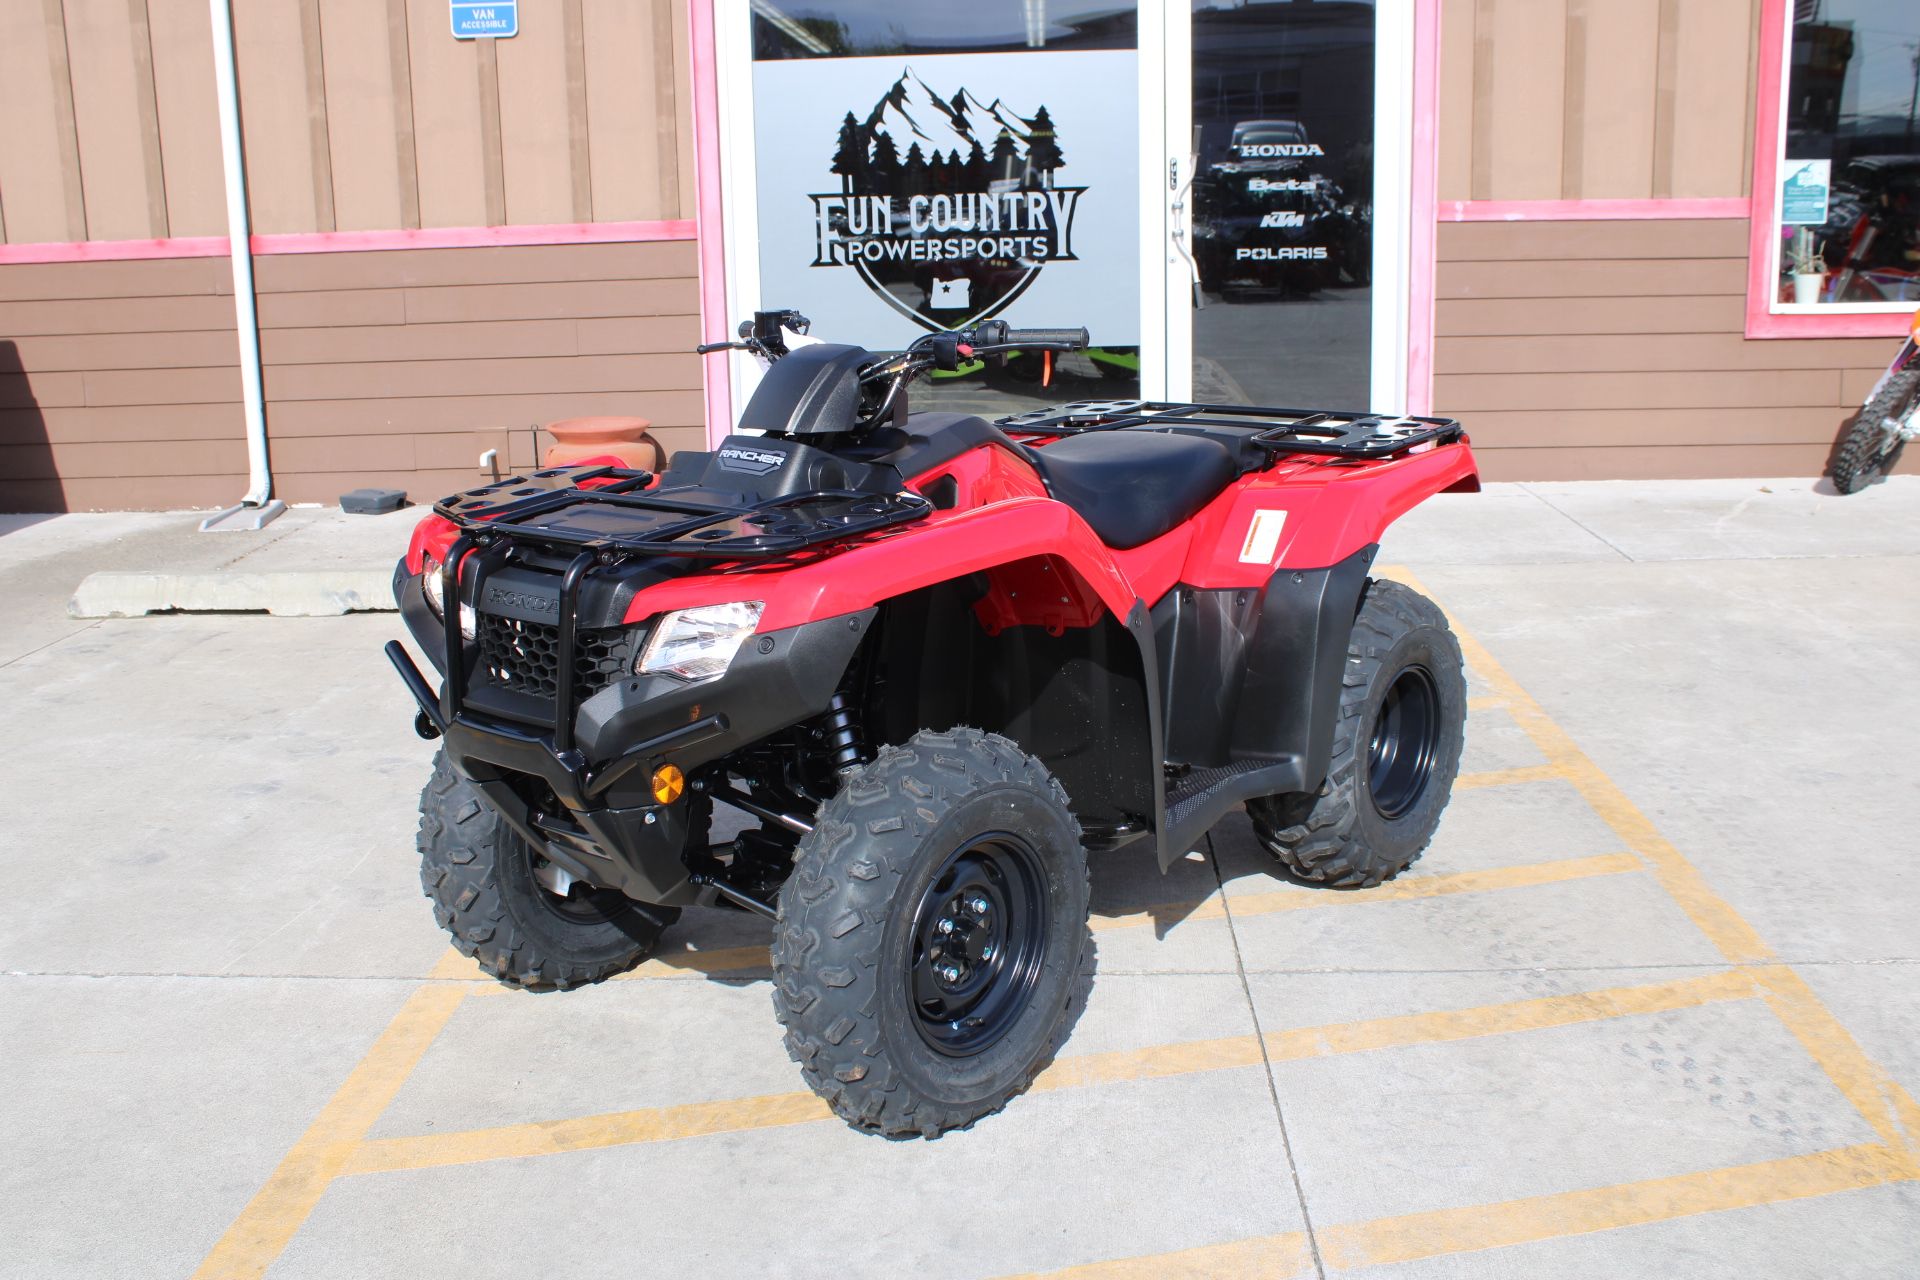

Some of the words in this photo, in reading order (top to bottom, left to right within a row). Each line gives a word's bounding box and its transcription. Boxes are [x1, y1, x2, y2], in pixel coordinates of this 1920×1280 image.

[472, 9, 495, 20] VAN
[461, 19, 507, 29] ACCESSIBLE
[1241, 144, 1324, 157] HONDA
[1248, 178, 1317, 191] Beta
[1260, 211, 1305, 227] KTM
[818, 195, 894, 263] FUN
[909, 190, 1078, 257] COUNTRY
[848, 236, 1049, 262] POWERSPORTS
[1236, 247, 1328, 260] POLARIS
[719, 449, 785, 466] RANCHER
[489, 588, 560, 615] HONDA
